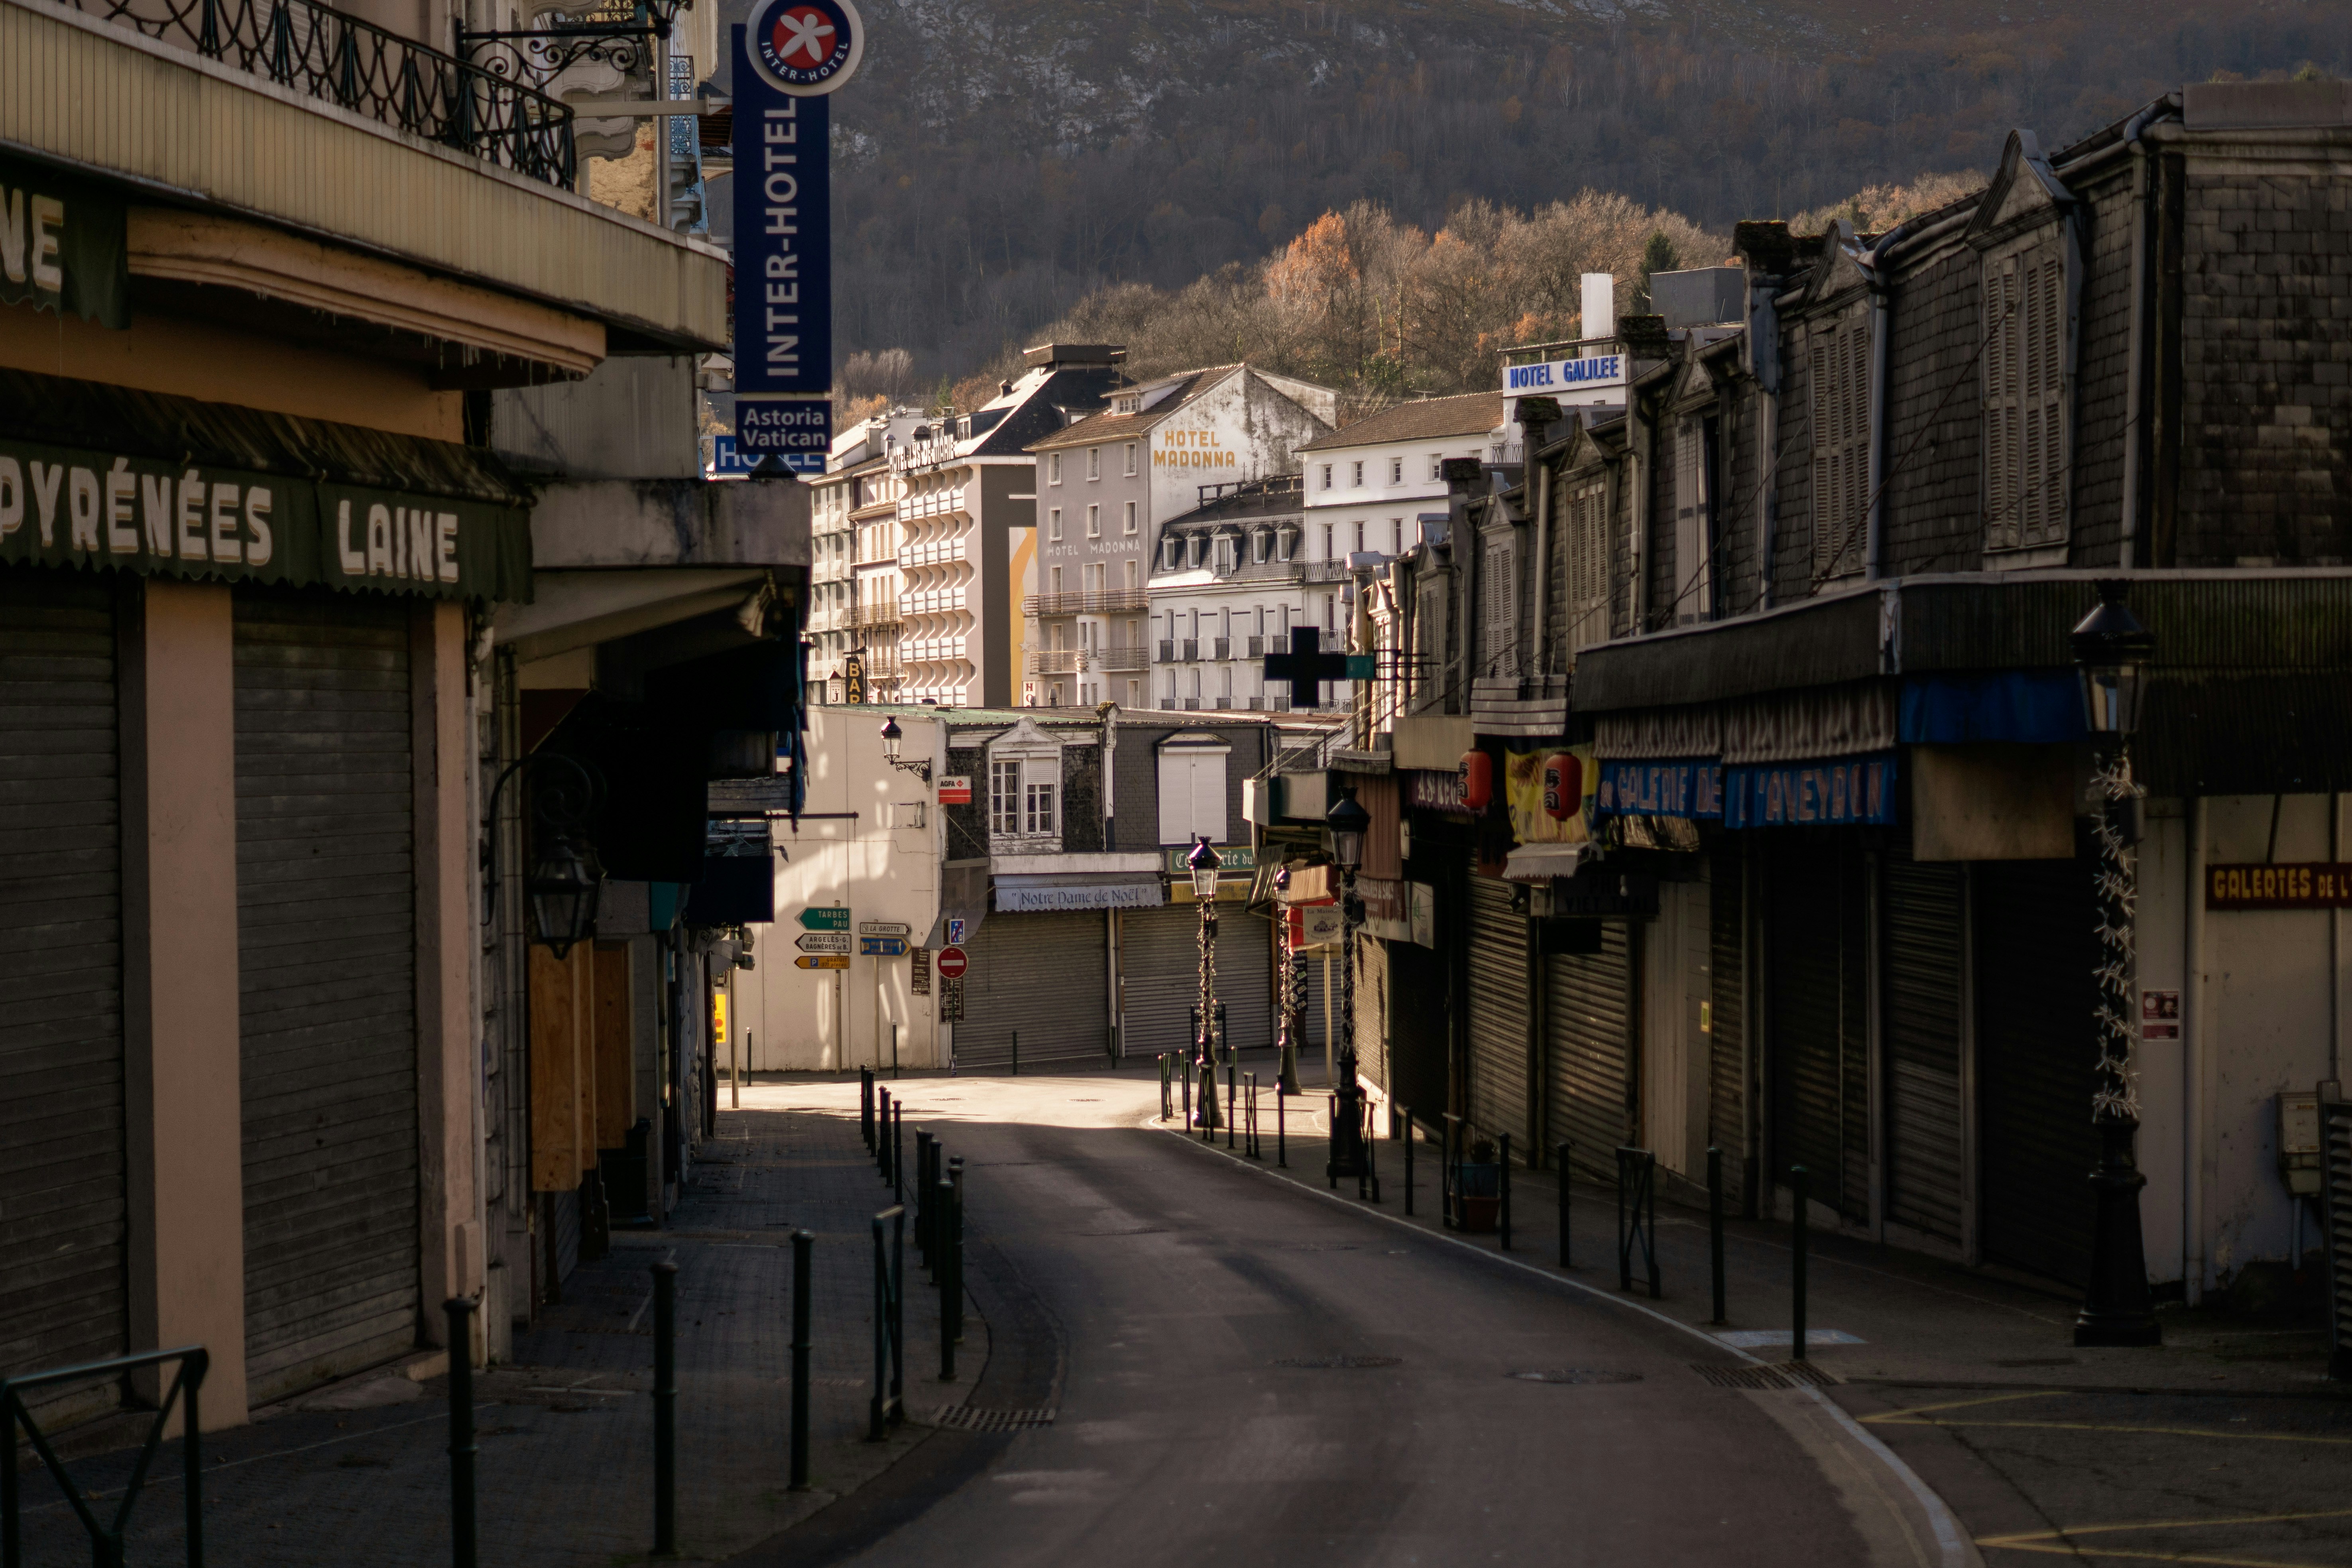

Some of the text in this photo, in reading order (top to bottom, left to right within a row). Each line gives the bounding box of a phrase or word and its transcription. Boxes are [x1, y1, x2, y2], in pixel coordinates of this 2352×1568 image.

[762, 42, 848, 81] INTER-HOTEL
[764, 97, 798, 376] INTER-HOTEL
[1510, 356, 1618, 389] HOTEL GALILEE
[744, 407, 824, 426] Astoria
[743, 428, 826, 447] Vatican
[1165, 431, 1220, 447] HOTEL
[889, 445, 907, 473] HOTEL
[907, 442, 921, 468] LYS
[932, 434, 954, 464] MARIE
[1153, 450, 1235, 466] MADONNA
[0, 456, 458, 583] PYRÉNÉES LAINE
[1047, 539, 1140, 557] HOTEL MADONNA
[849, 663, 860, 704] BAR
[832, 693, 840, 702] J
[1058, 890, 1091, 904] Dame
[1095, 889, 1107, 903] de
[2318, 874, 2334, 899] DE
